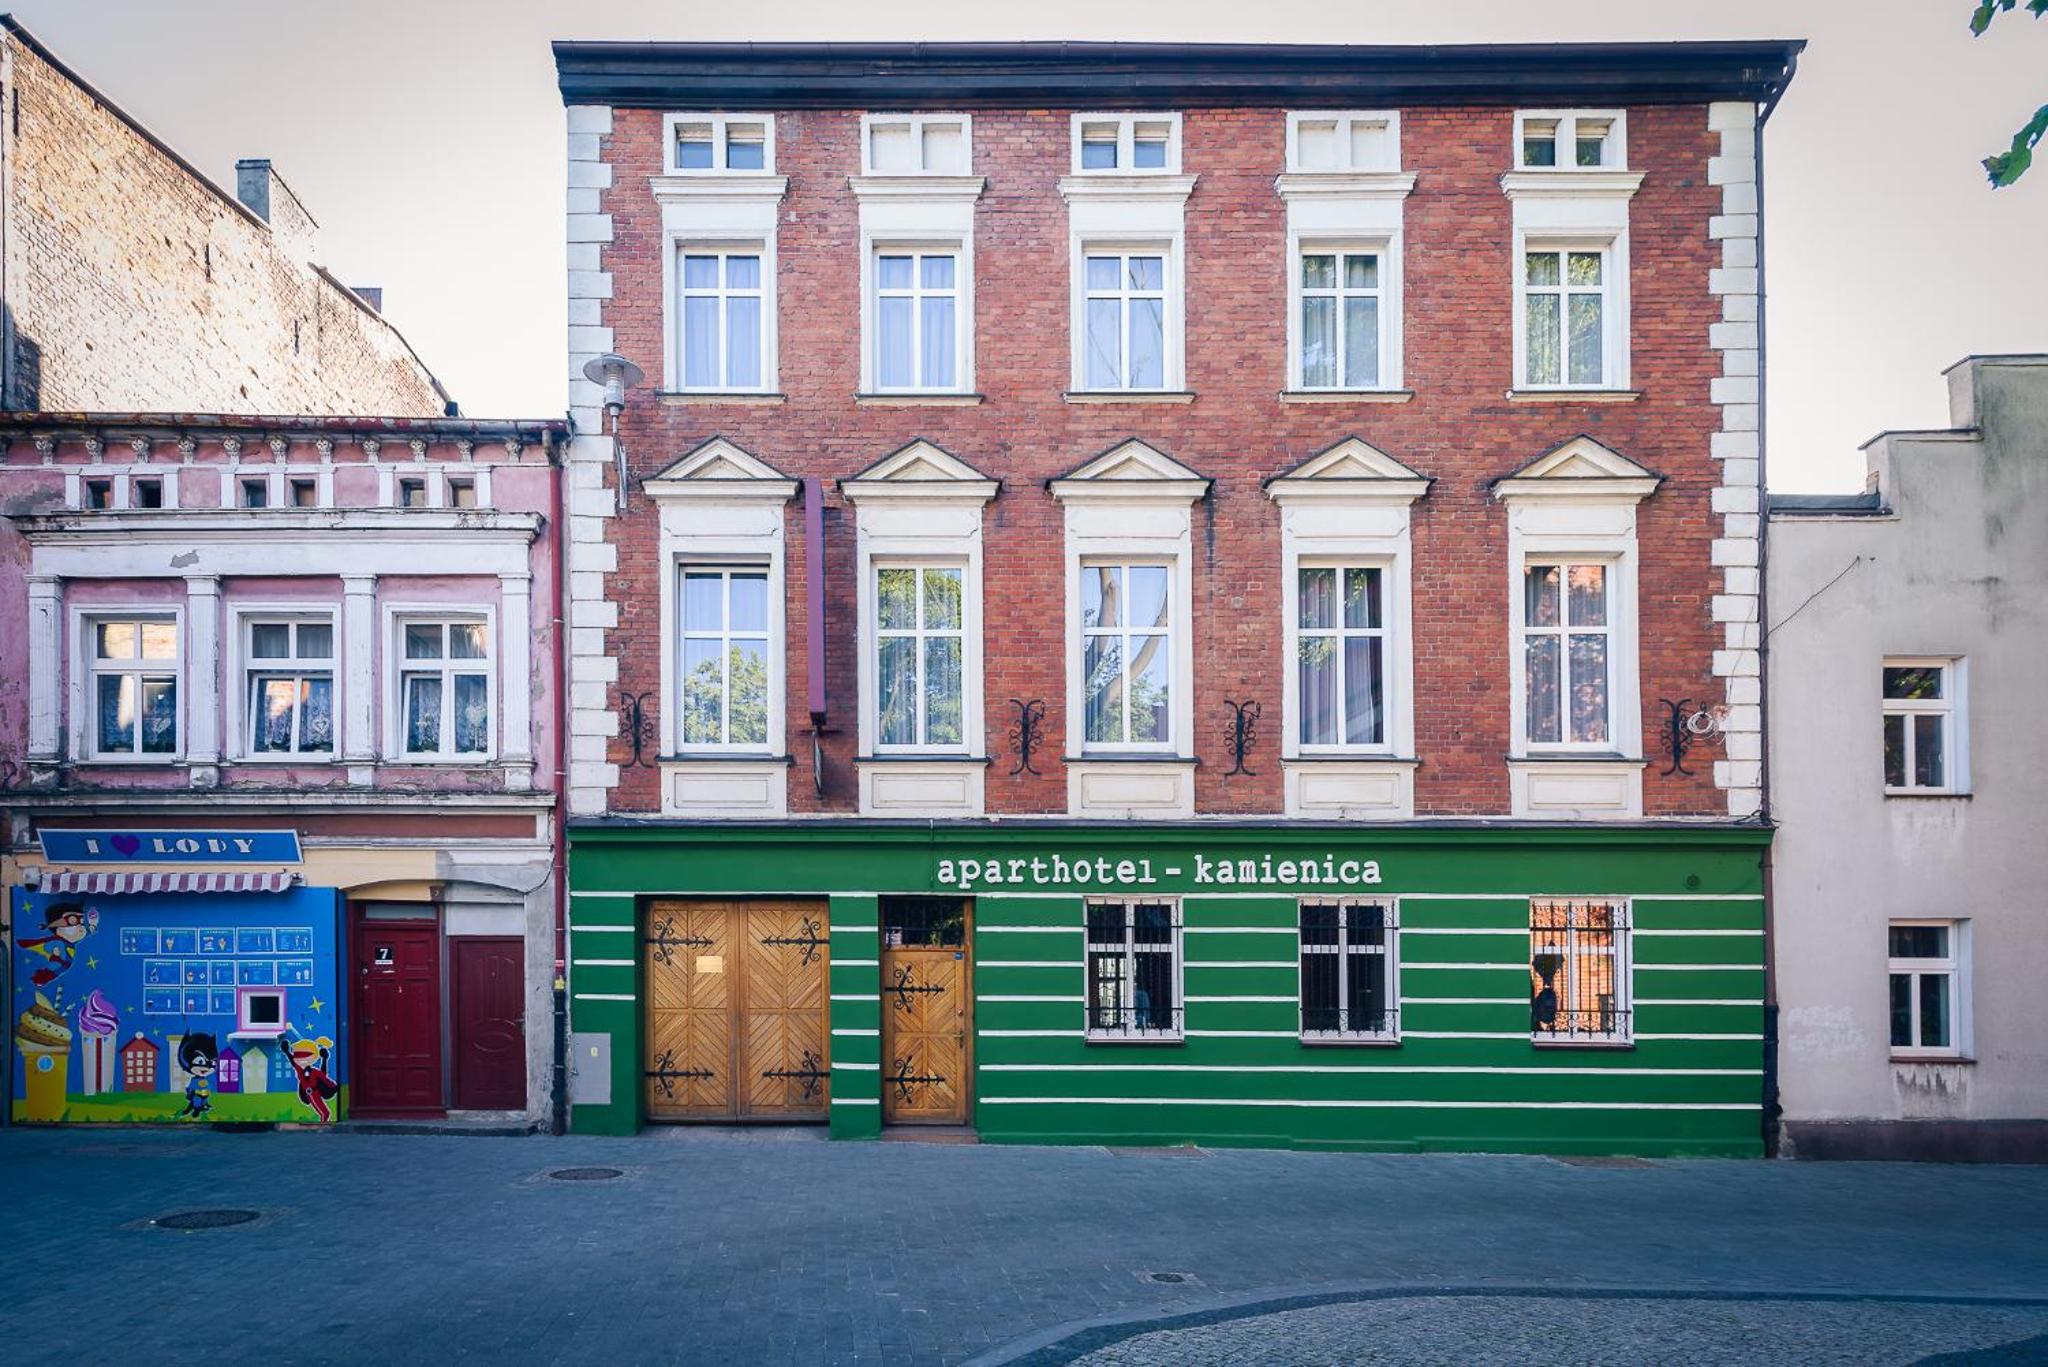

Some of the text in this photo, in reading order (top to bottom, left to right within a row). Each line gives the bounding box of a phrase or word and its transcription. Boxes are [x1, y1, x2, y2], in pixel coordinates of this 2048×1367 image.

[86, 838, 253, 854] I LODY
[937, 854, 1382, 889] aparthotel - kamienica
[379, 948, 389, 960] 7
